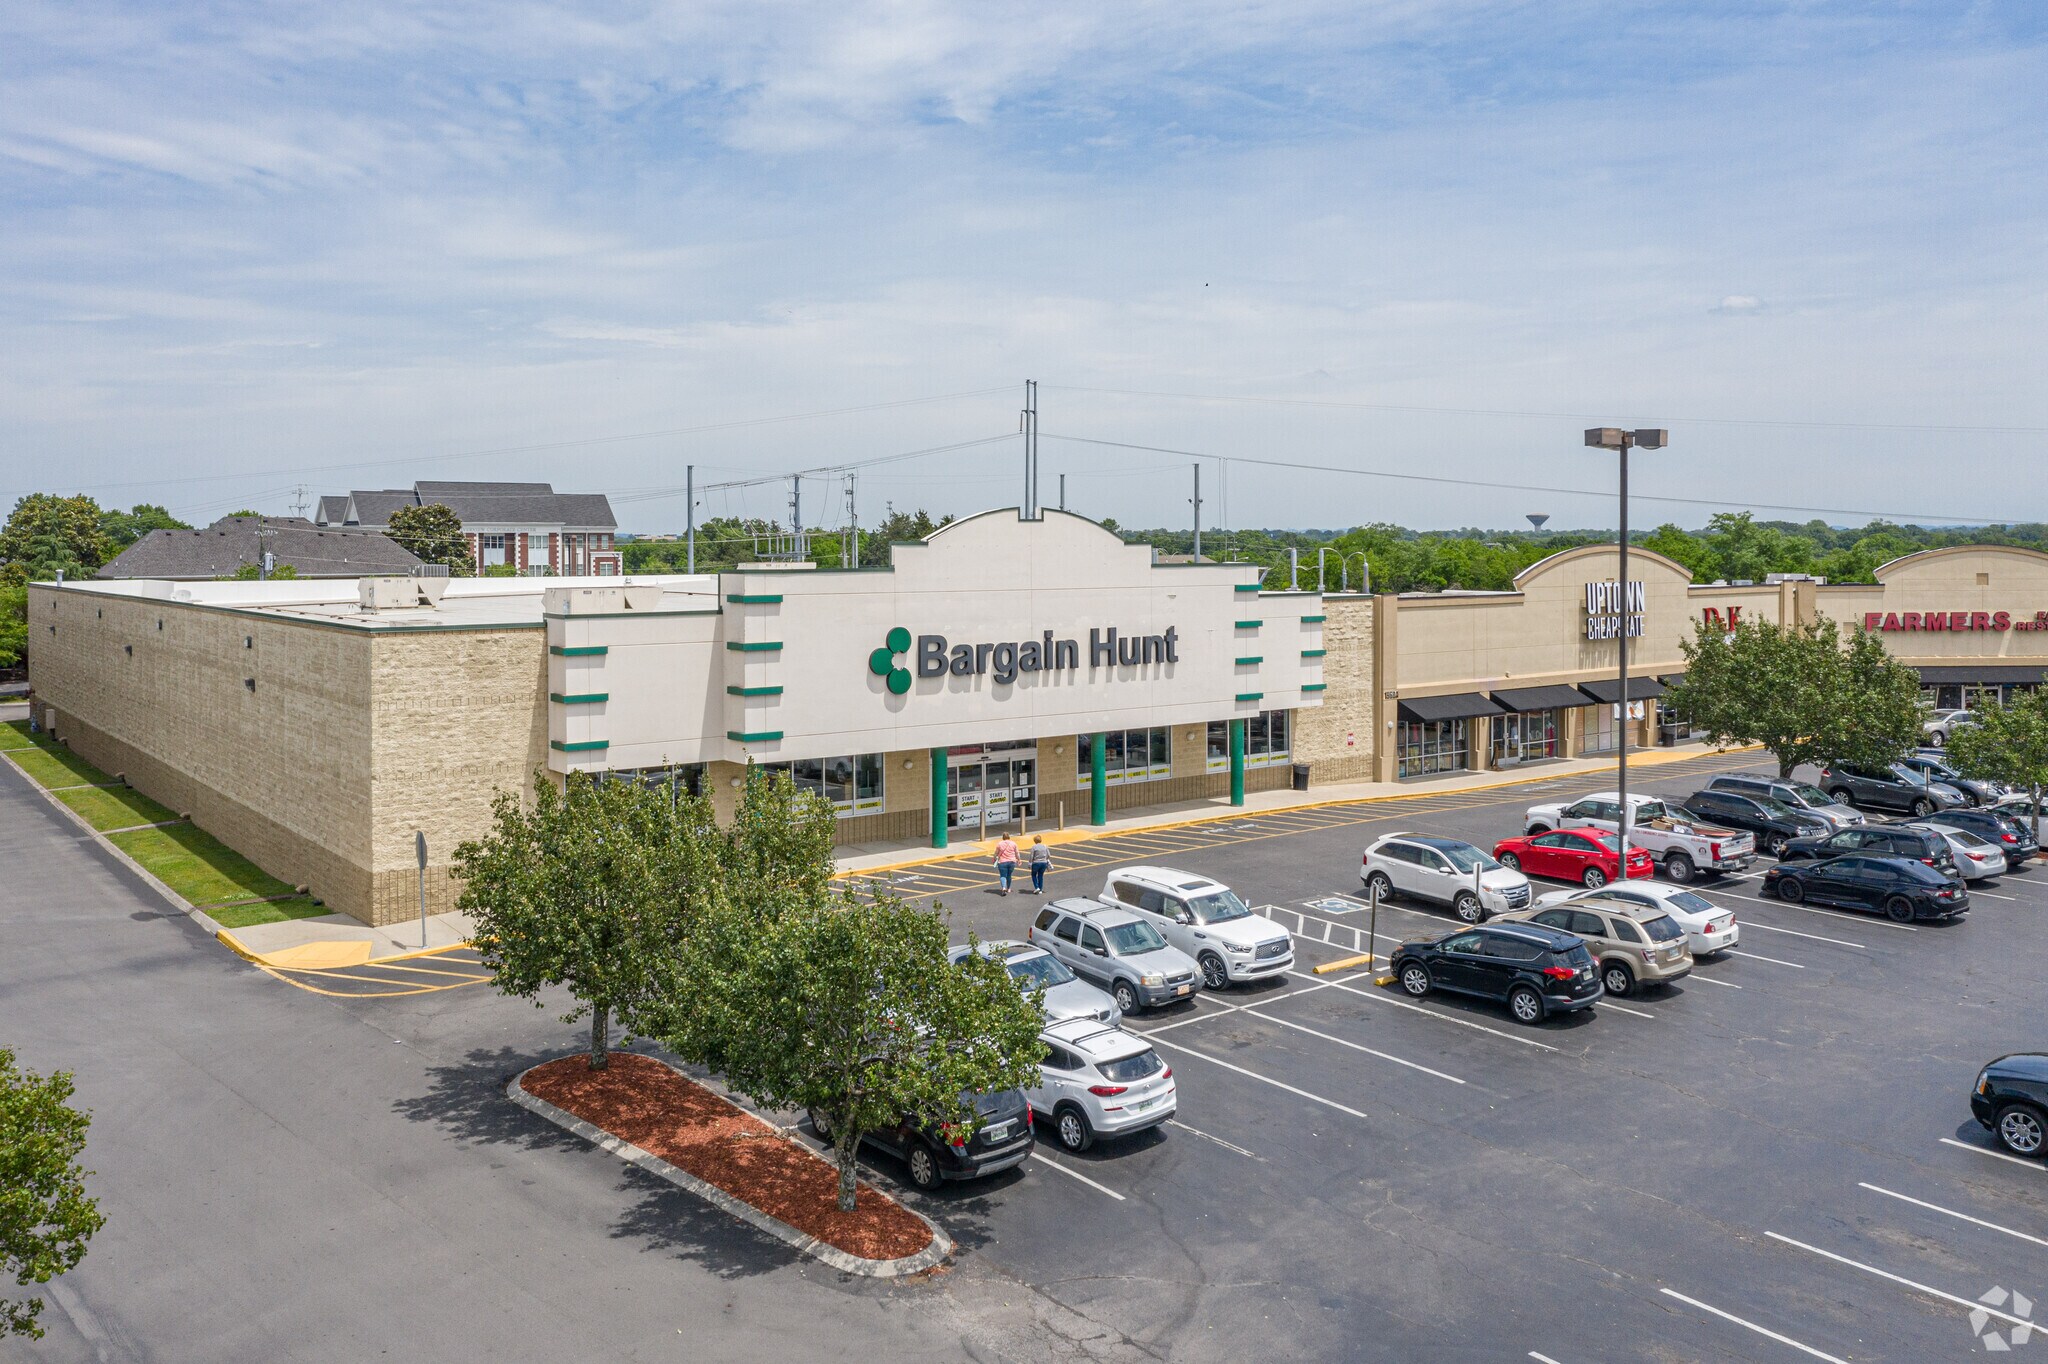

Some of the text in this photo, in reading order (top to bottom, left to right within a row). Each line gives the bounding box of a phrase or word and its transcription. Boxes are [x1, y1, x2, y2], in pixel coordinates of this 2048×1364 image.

[1585, 581, 1645, 615] UPTOWN
[1586, 615, 1646, 640] CHEAPATE
[1864, 611, 2011, 632] FARMERS
[917, 625, 1179, 684] Bargain Hunt
